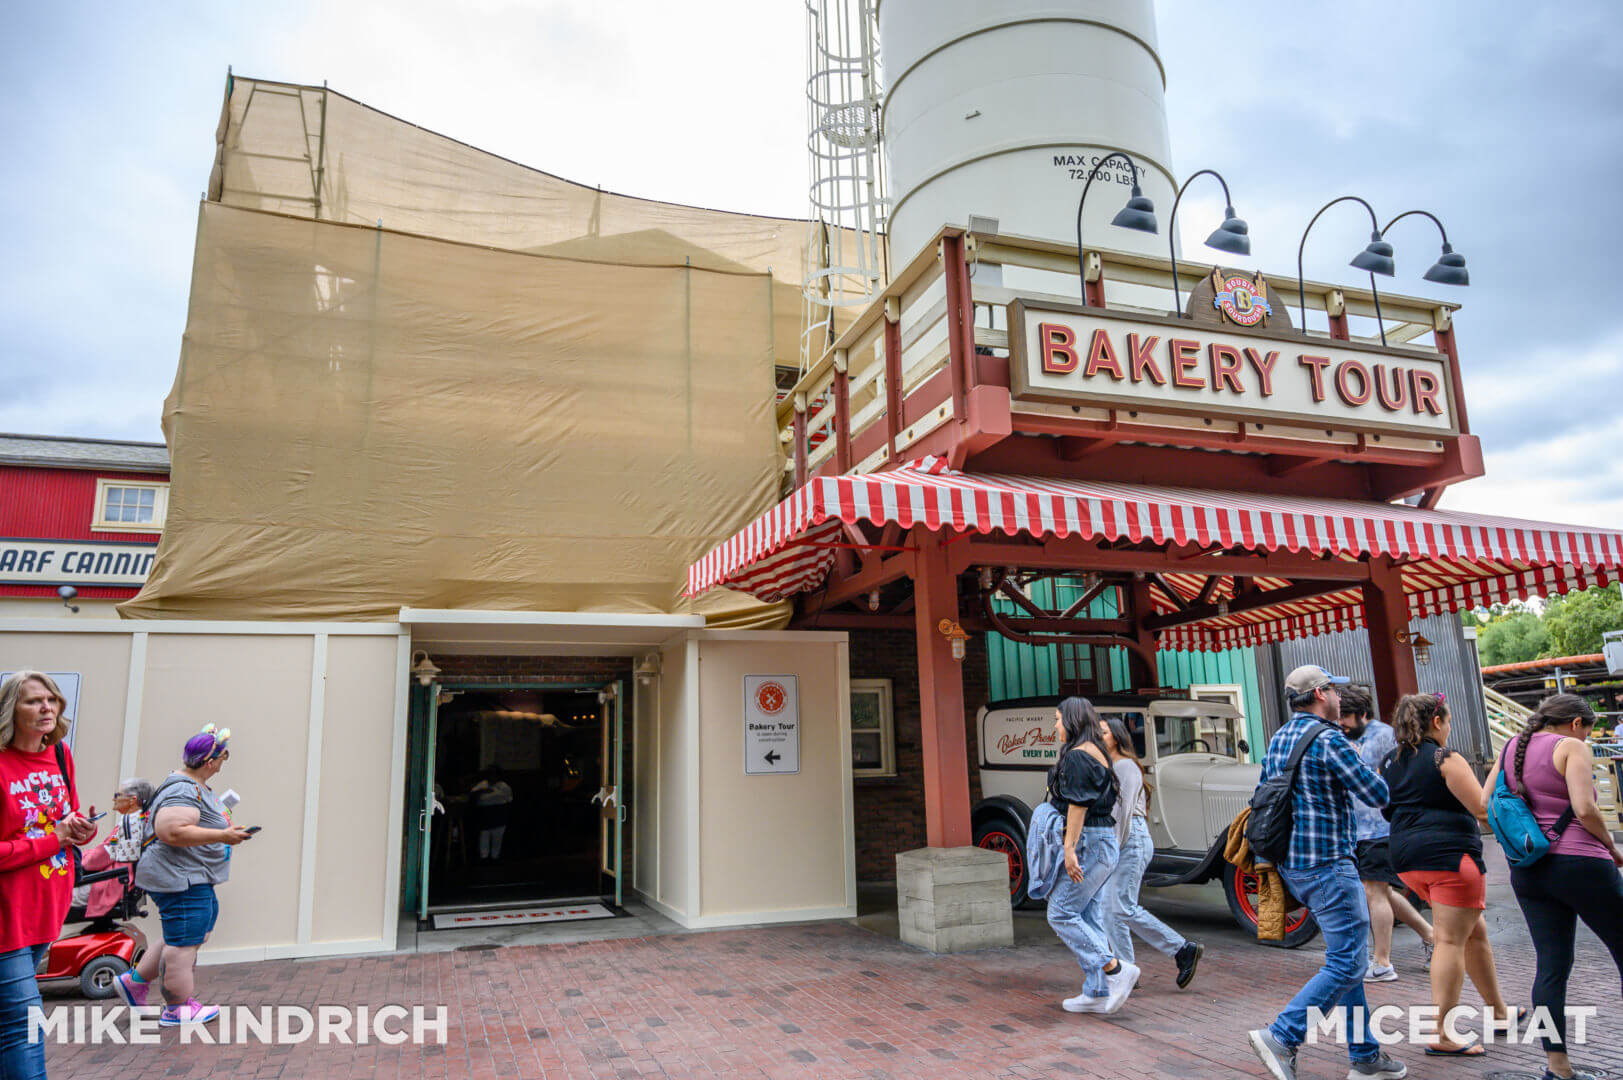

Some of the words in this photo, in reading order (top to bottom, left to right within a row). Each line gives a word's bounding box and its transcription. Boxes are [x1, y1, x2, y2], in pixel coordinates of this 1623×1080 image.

[1053, 156, 1086, 166] MAX
[1091, 156, 1146, 178] CAPACTY
[1226, 279, 1256, 294] BOUDIN
[1225, 302, 1262, 323] SOURDOUGH
[1039, 322, 1280, 397] BAKERY
[1298, 354, 1443, 415] TOUR
[749, 723, 775, 731] Bakery
[997, 731, 1028, 755] Baked
[1028, 727, 1056, 747] Fresh
[1022, 749, 1042, 758] EVERY
[1044, 749, 1057, 758] DAY
